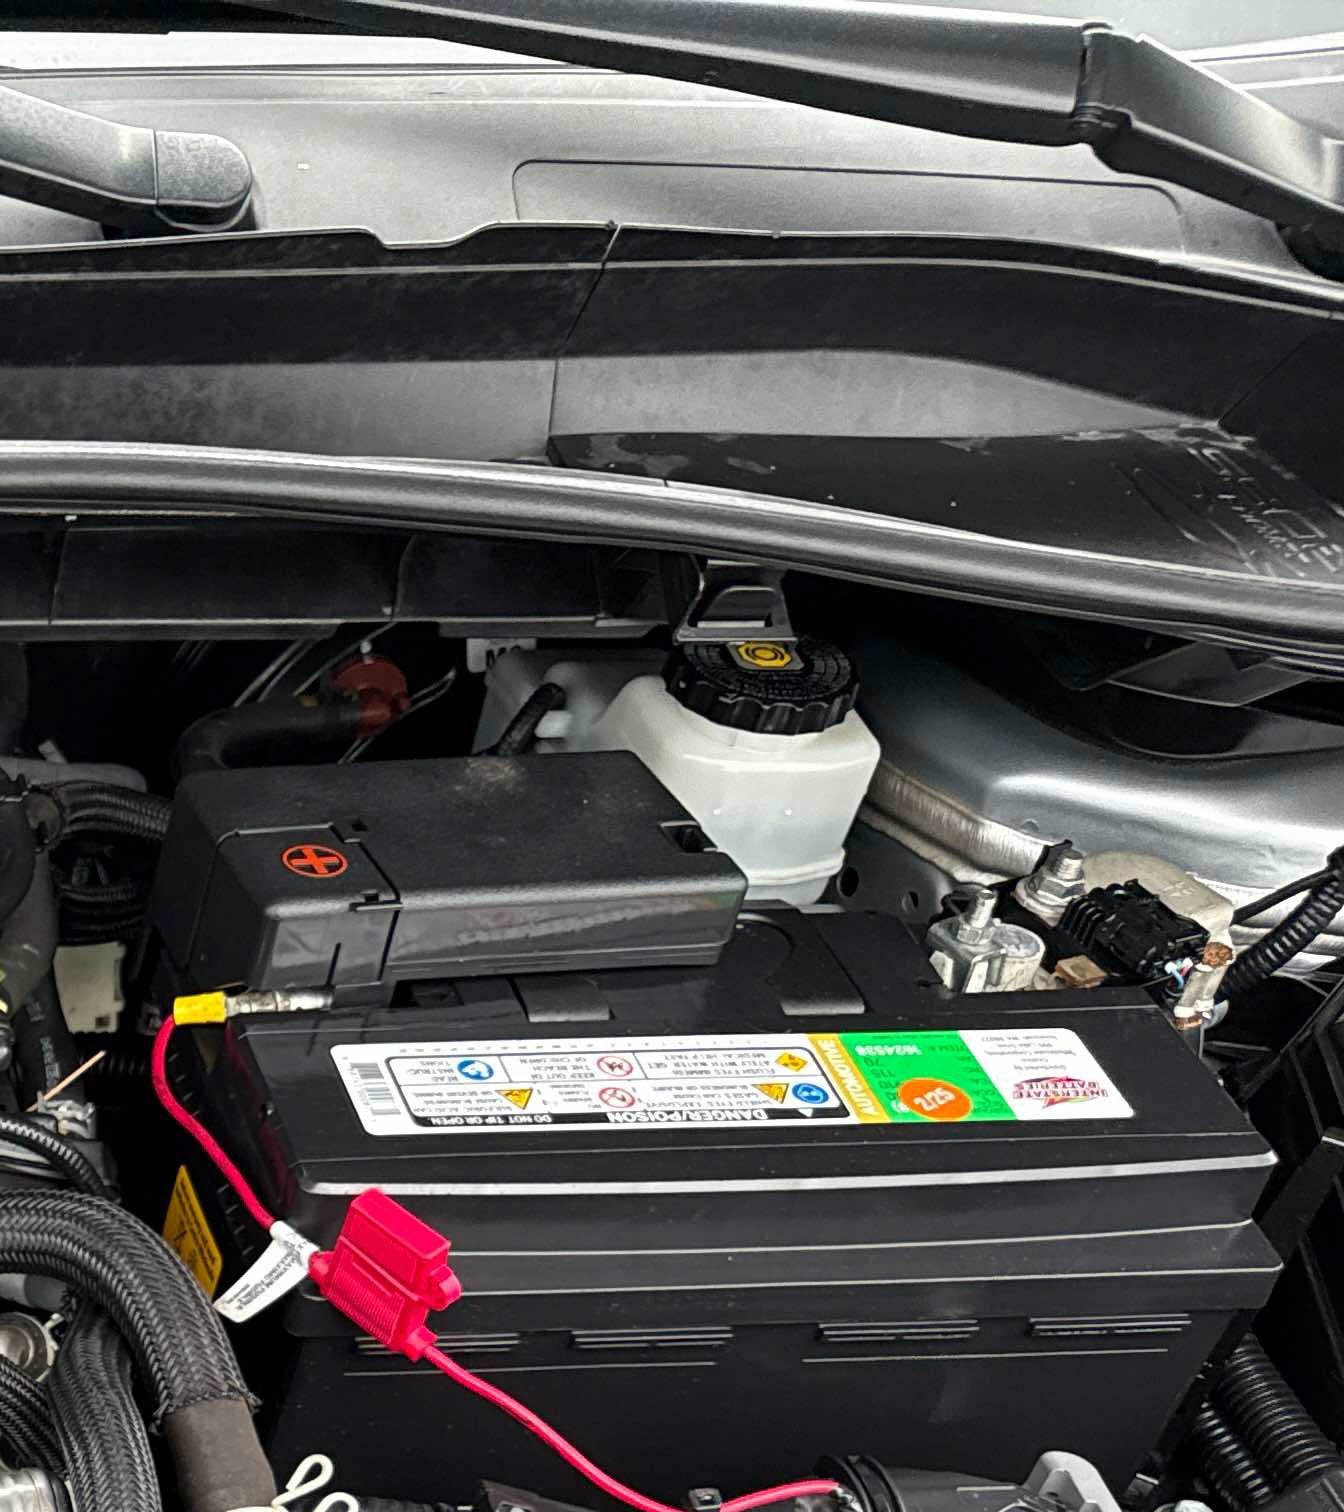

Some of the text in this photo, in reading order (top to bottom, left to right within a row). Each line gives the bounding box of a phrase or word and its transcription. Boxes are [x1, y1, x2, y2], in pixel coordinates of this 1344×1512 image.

[817, 1039, 876, 1117] AUTOMOTIVE
[1013, 1081, 1099, 1091] BATTERIES
[913, 1087, 956, 1111] 2/25
[1012, 1089, 1108, 1100] INTERSTATE
[463, 1116, 483, 1125] OR
[484, 1115, 502, 1124] TIP
[509, 1114, 533, 1124] NOT
[535, 1114, 553, 1123] DO
[607, 1109, 768, 1123] DANGER/POISON
